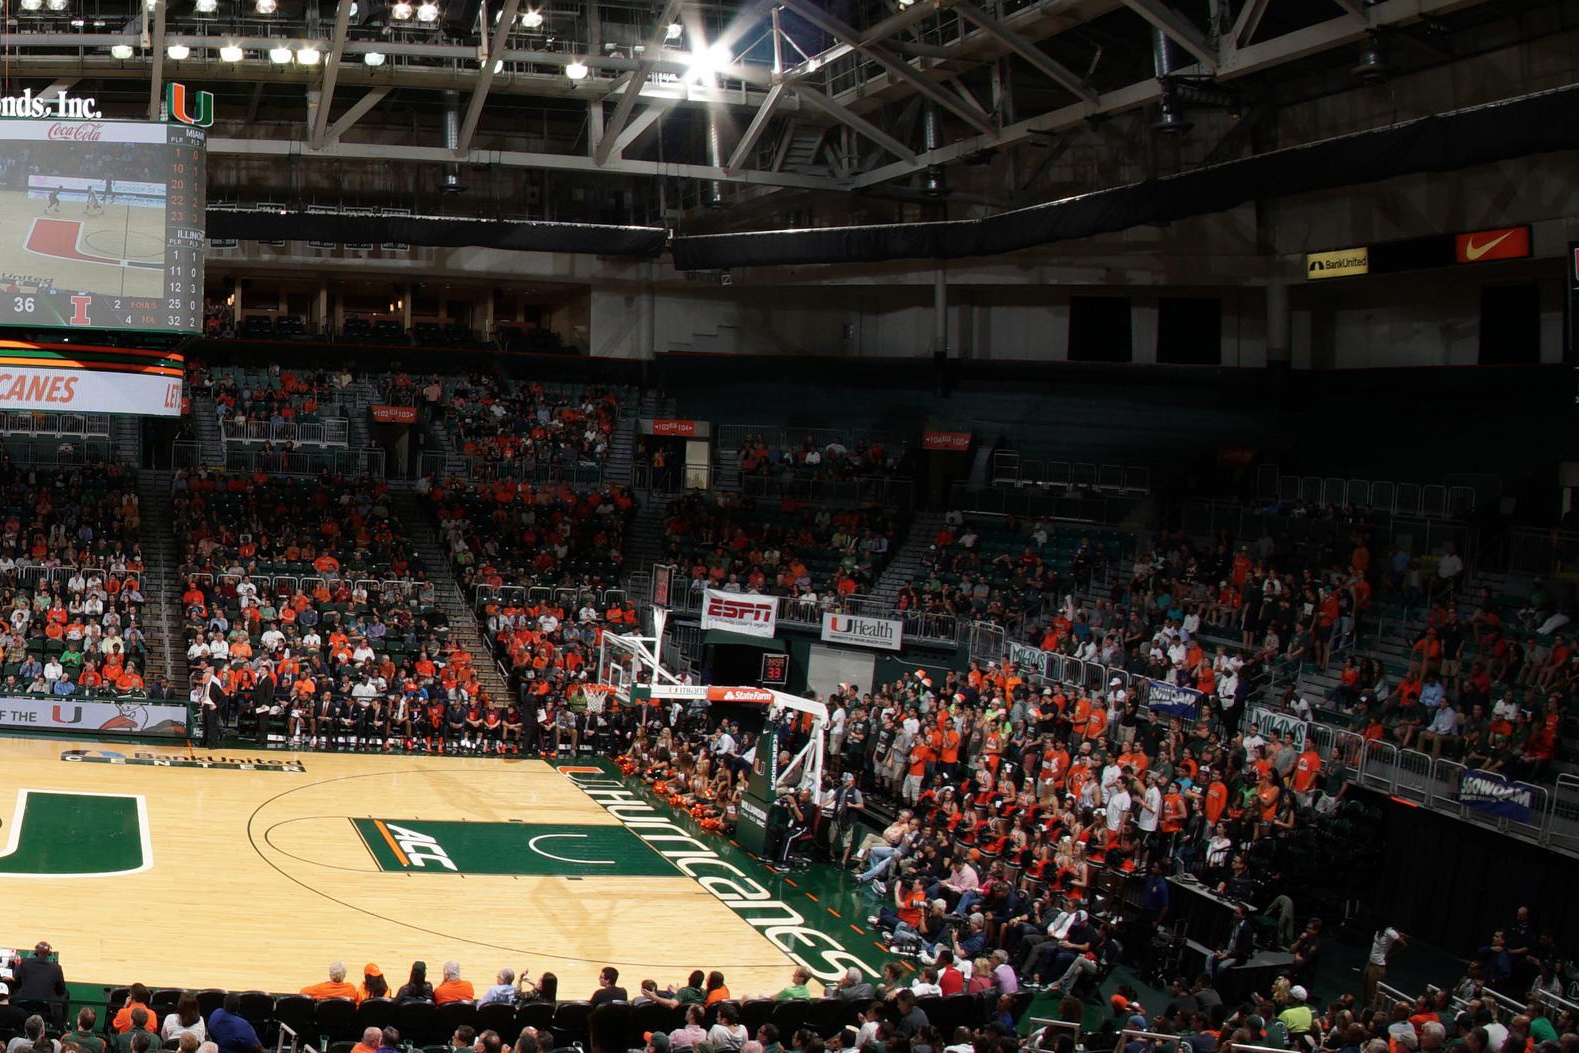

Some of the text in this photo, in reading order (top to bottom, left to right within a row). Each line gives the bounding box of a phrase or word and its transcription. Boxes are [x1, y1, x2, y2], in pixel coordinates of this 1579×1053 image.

[57, 91, 102, 118] Inc.
[167, 82, 214, 127] U
[1325, 258, 1366, 270] BankUnited
[170, 266, 196, 277] 11 0
[170, 282, 196, 293] 12 3
[13, 297, 35, 312] 36
[114, 300, 121, 309] 2
[168, 299, 195, 310] 25 0
[125, 315, 132, 324] 4
[167, 316, 195, 327] 32 2
[708, 598, 772, 622] ESPN
[831, 616, 893, 639] UHealth
[11, 710, 38, 723] THE
[134, 752, 303, 766] BankUnited
[386, 823, 459, 872] ACC
